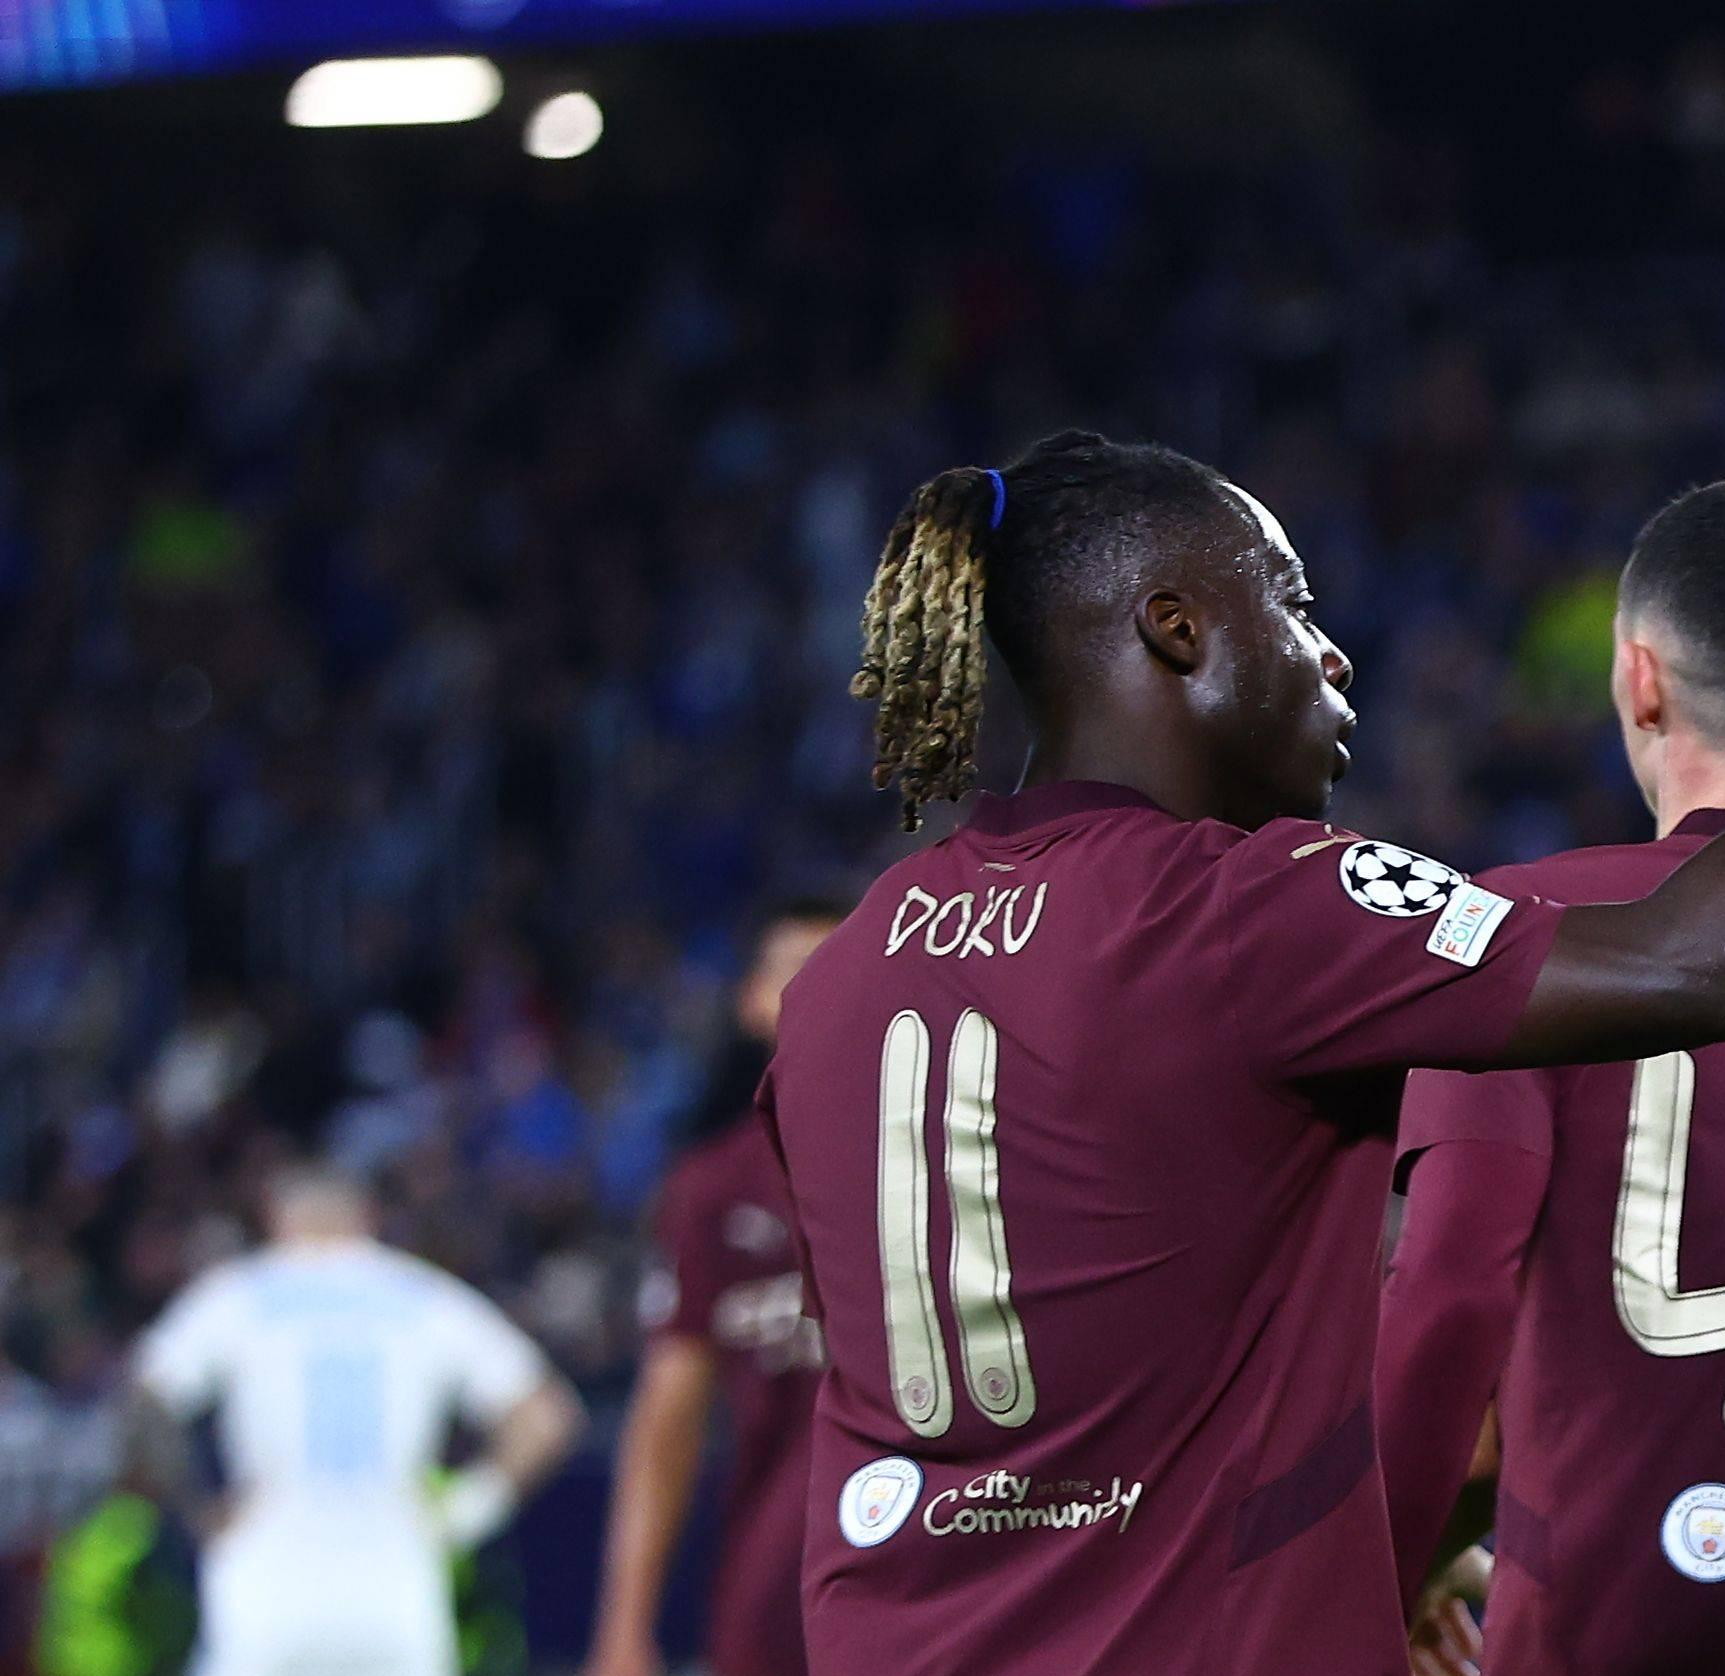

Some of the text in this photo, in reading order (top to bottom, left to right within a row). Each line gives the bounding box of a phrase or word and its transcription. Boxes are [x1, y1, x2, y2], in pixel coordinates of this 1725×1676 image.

[884, 882, 1048, 959] DOKU
[877, 1006, 1037, 1438] 11
[963, 1469, 1031, 1503] City
